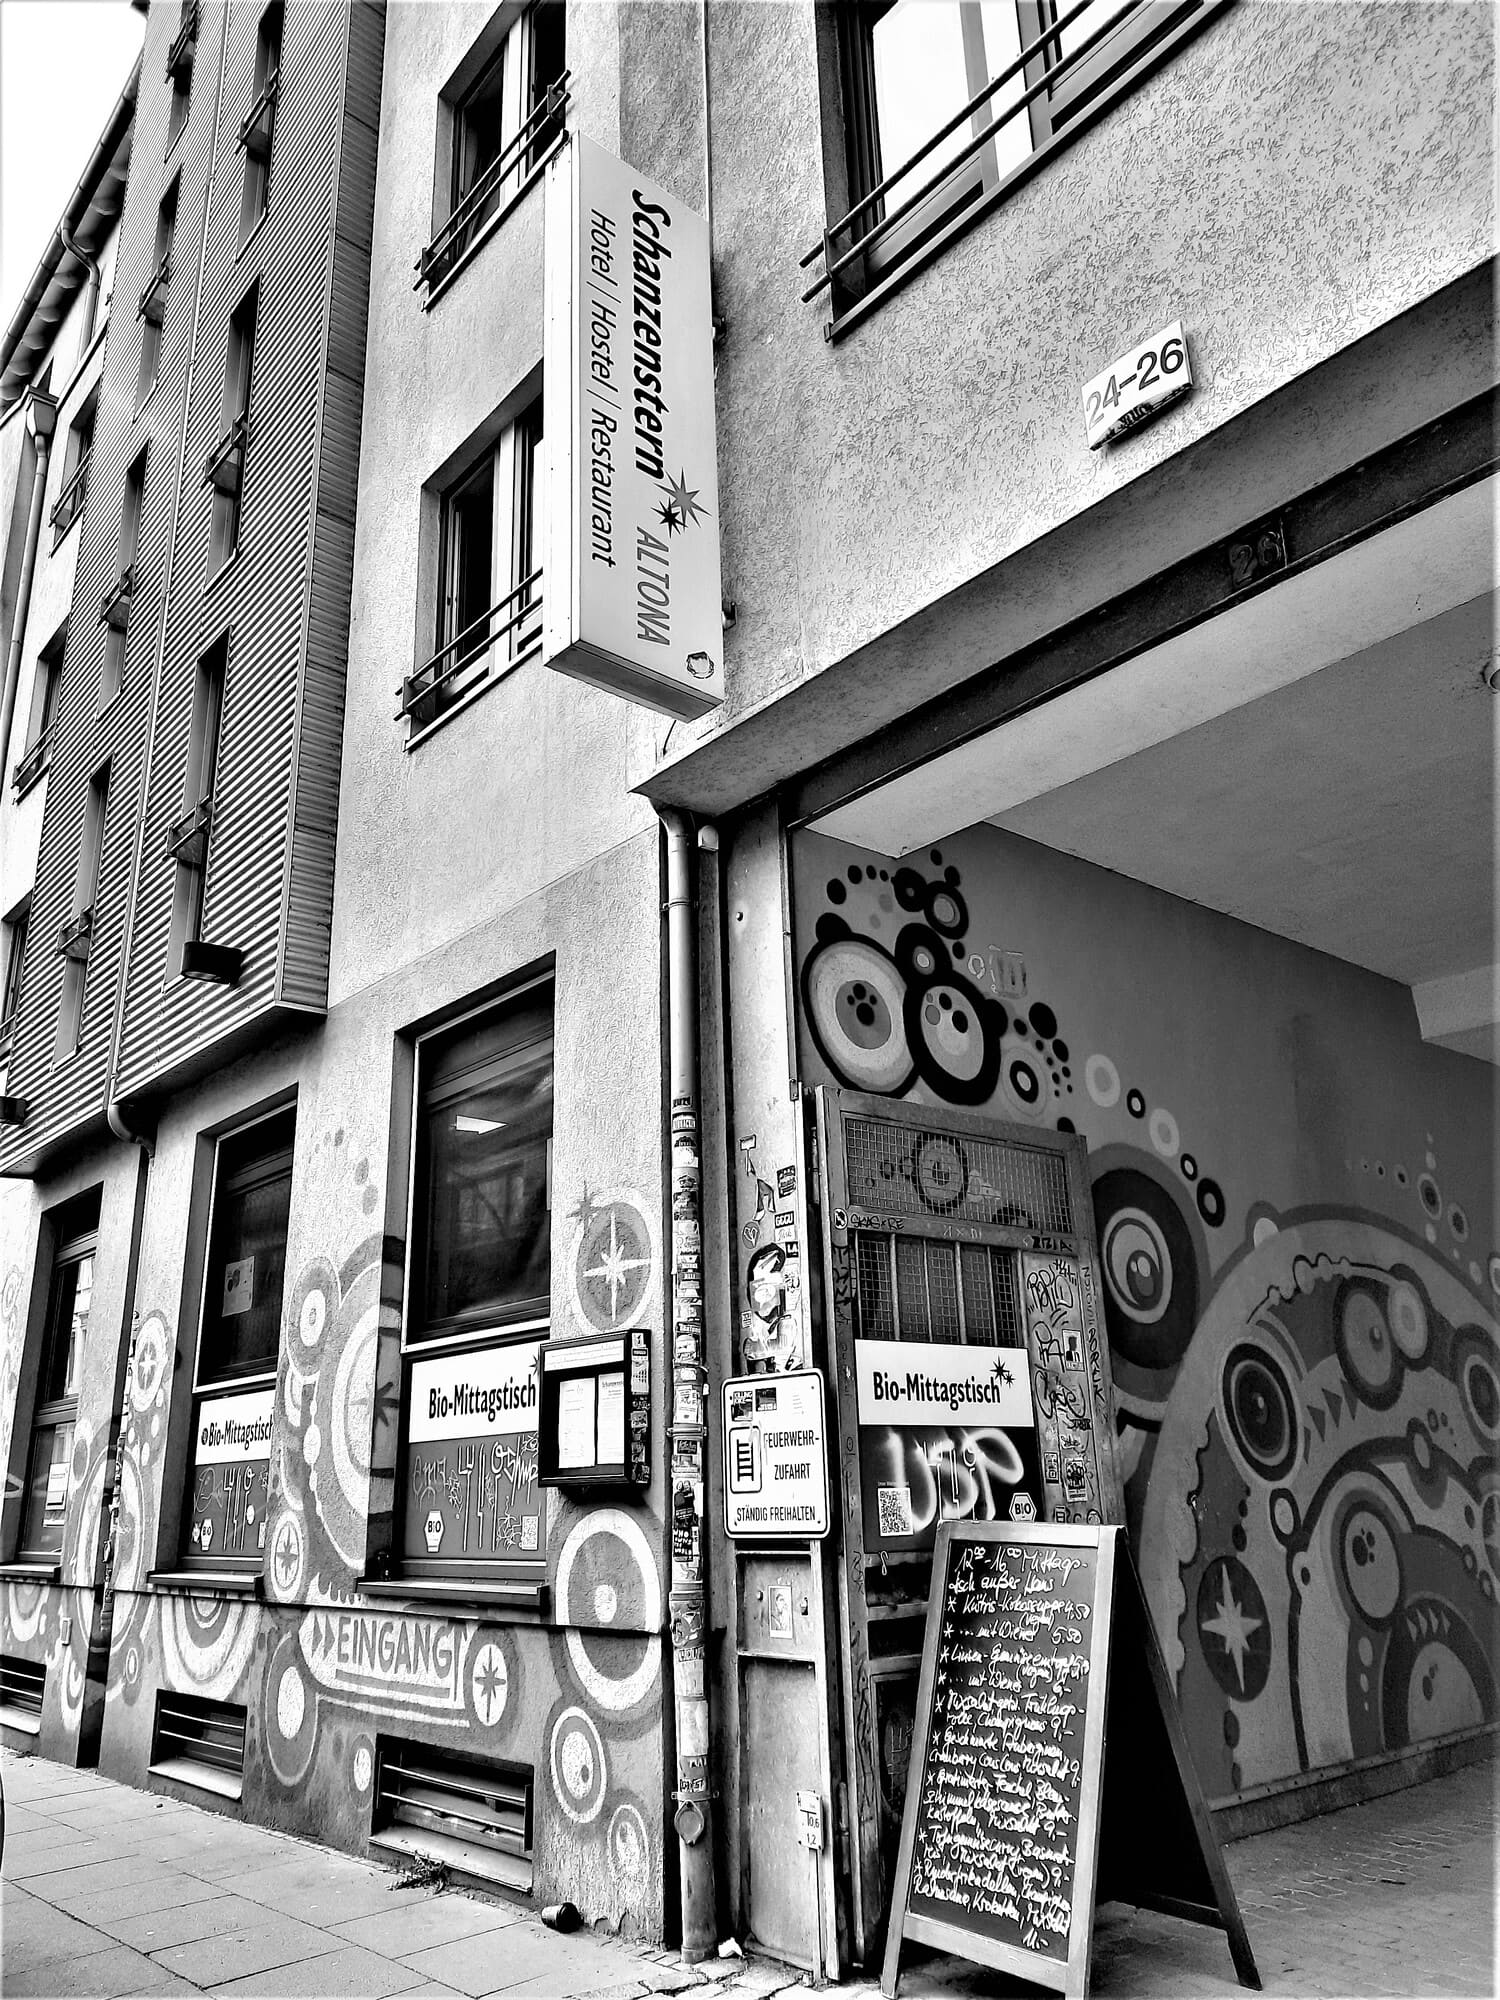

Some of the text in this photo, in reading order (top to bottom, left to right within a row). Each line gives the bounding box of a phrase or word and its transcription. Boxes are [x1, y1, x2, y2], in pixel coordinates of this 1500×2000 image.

[591, 208, 618, 287] Hotel
[591, 299, 619, 393] Hostel
[632, 188, 672, 481] Schanzenstern
[1085, 338, 1185, 428] 24-26
[591, 407, 617, 569] Restaurant
[636, 525, 671, 647] ALTONA
[428, 1373, 537, 1422] Bio-Mittagstisch
[873, 1370, 1001, 1411] Bio-Mittagstisch
[763, 1429, 820, 1449] FEUERWEHR-
[774, 1463, 812, 1481] ZUFAHRT
[736, 1504, 816, 1522] STÄNDIG FREIHALTEN
[1014, 1502, 1032, 1516] BIO
[981, 1570, 1021, 1600] außer
[1024, 1571, 1055, 1596] Haus
[336, 1615, 452, 1680] EINGANG
